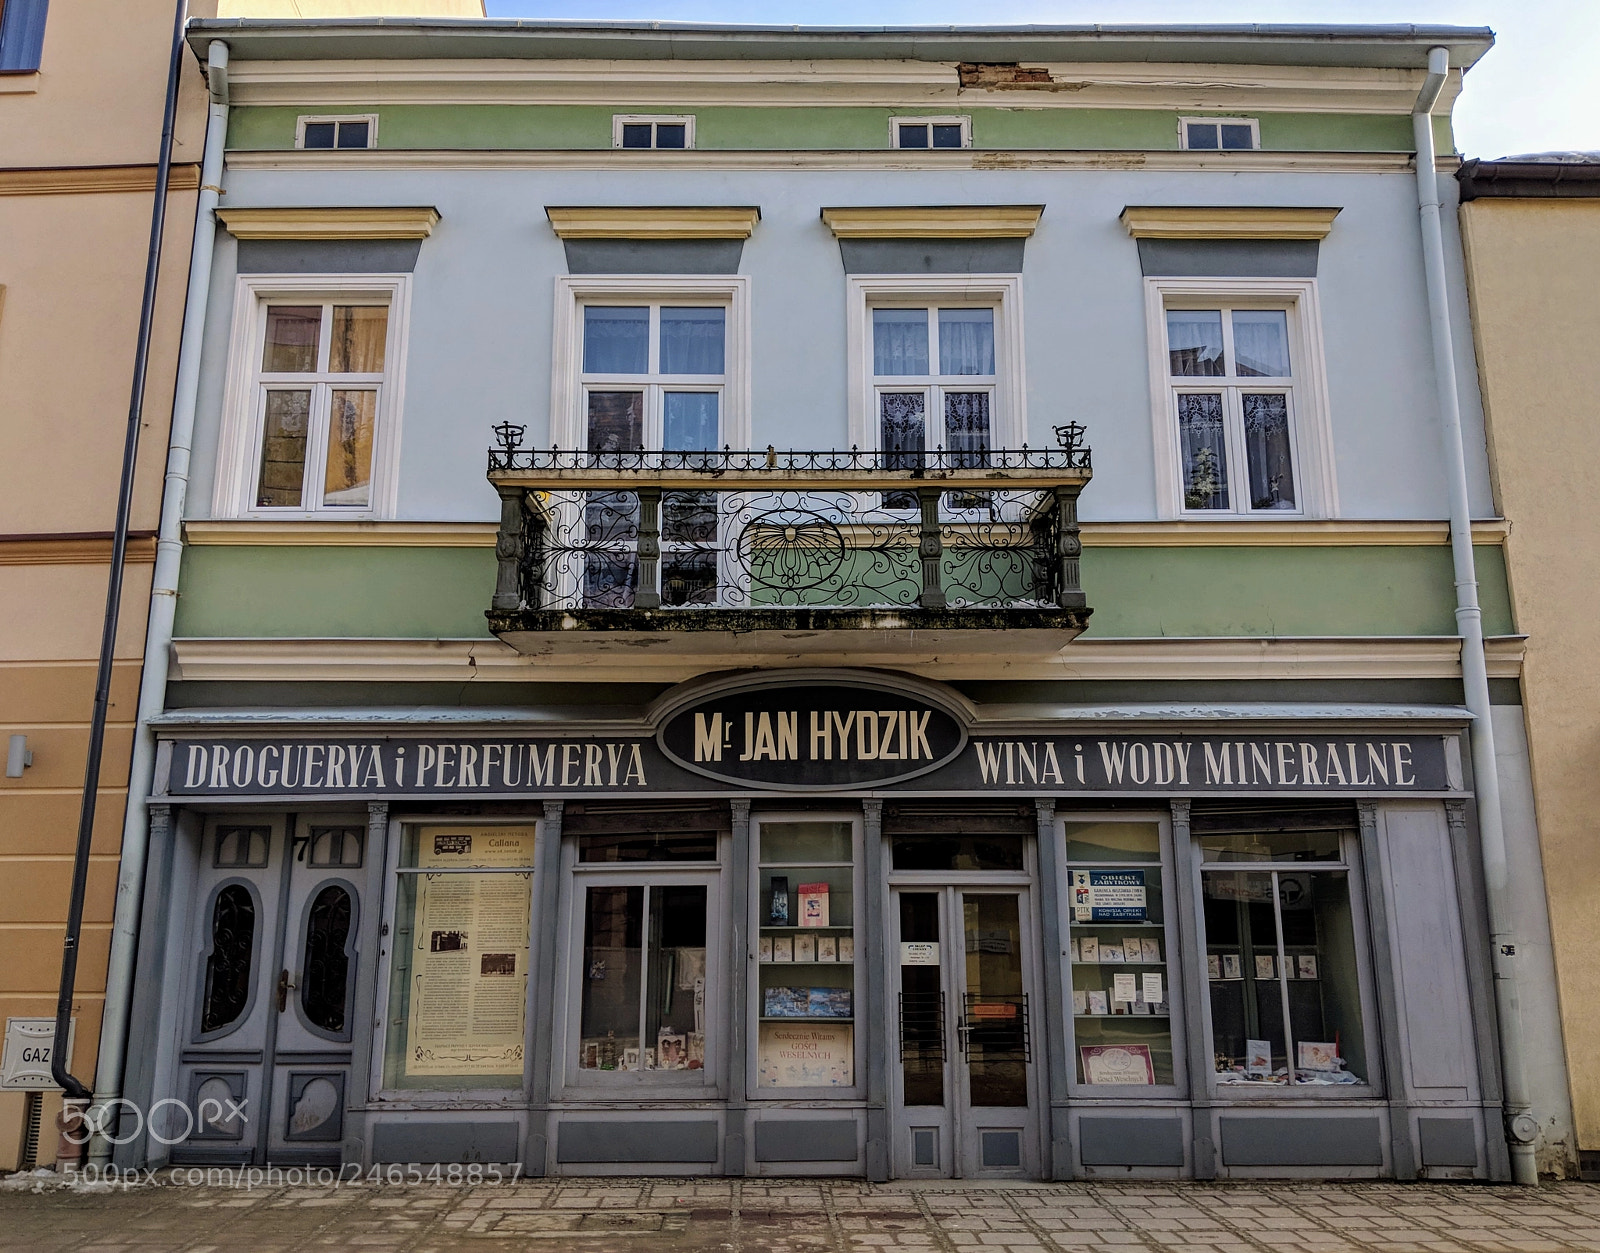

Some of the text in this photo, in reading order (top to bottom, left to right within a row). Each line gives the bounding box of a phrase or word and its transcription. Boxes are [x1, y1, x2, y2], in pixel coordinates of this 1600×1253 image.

[739, 711, 798, 761] JAN
[810, 710, 934, 760] HYDZIK
[184, 743, 648, 788] DROGUERYA i PERFUMERYA
[974, 741, 1416, 786] WINA i WODY MINERALNE
[293, 836, 310, 862] 7
[488, 838, 520, 848] Callana
[811, 1032, 836, 1041] Witamy
[22, 1047, 51, 1063] GAZ
[779, 1050, 832, 1060] WESELNYCH
